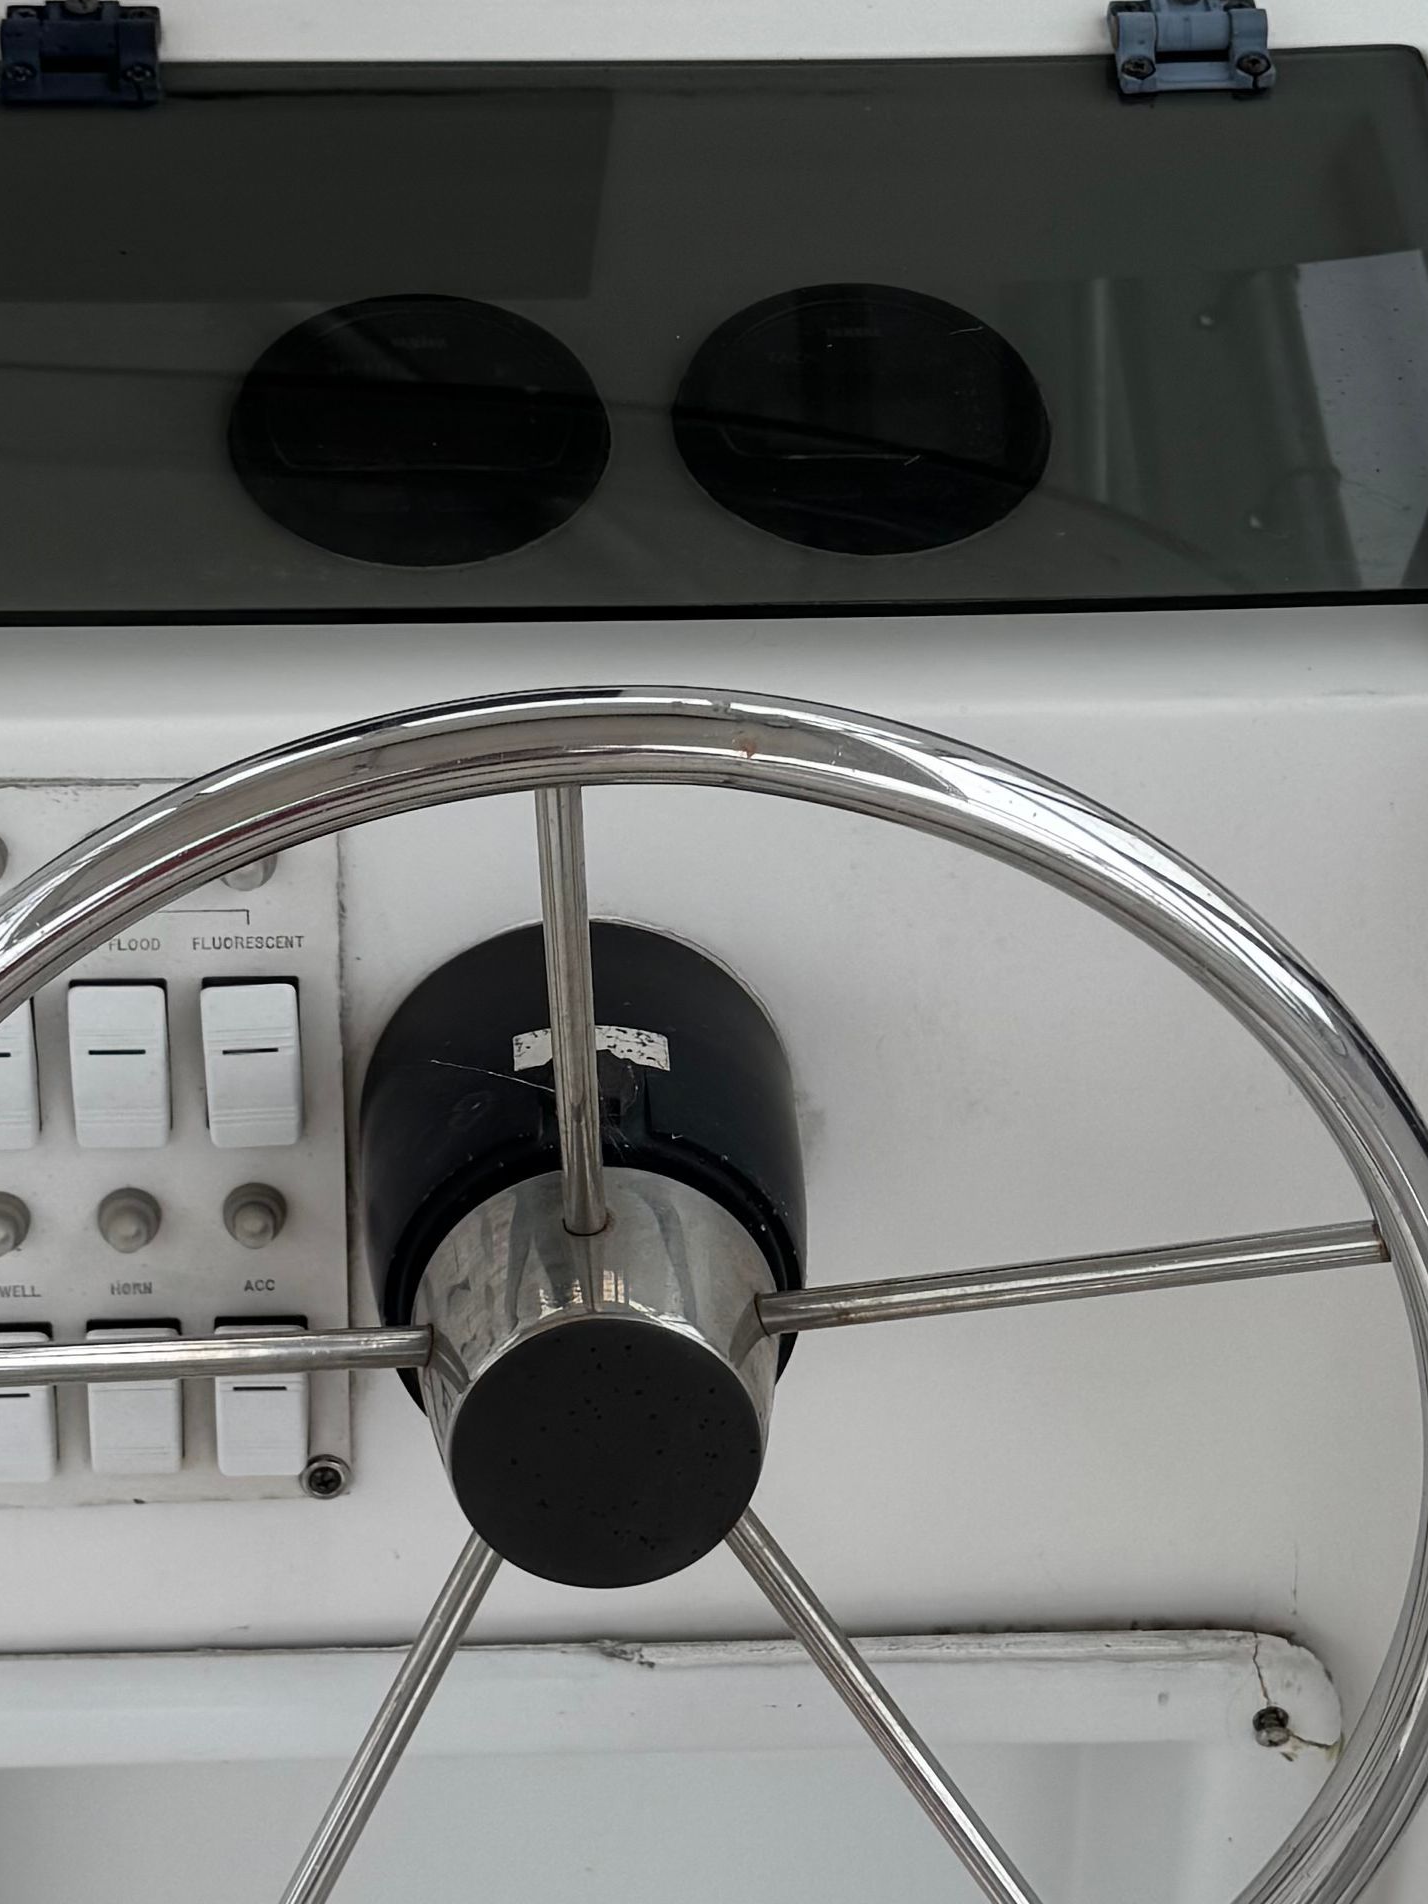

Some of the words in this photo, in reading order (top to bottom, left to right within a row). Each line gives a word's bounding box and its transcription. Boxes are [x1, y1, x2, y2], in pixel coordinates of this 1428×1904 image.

[108, 937, 161, 951] FLOOD
[192, 935, 304, 951] FLUORESCENT
[110, 1281, 153, 1295] HORN
[244, 1279, 276, 1292] ACC
